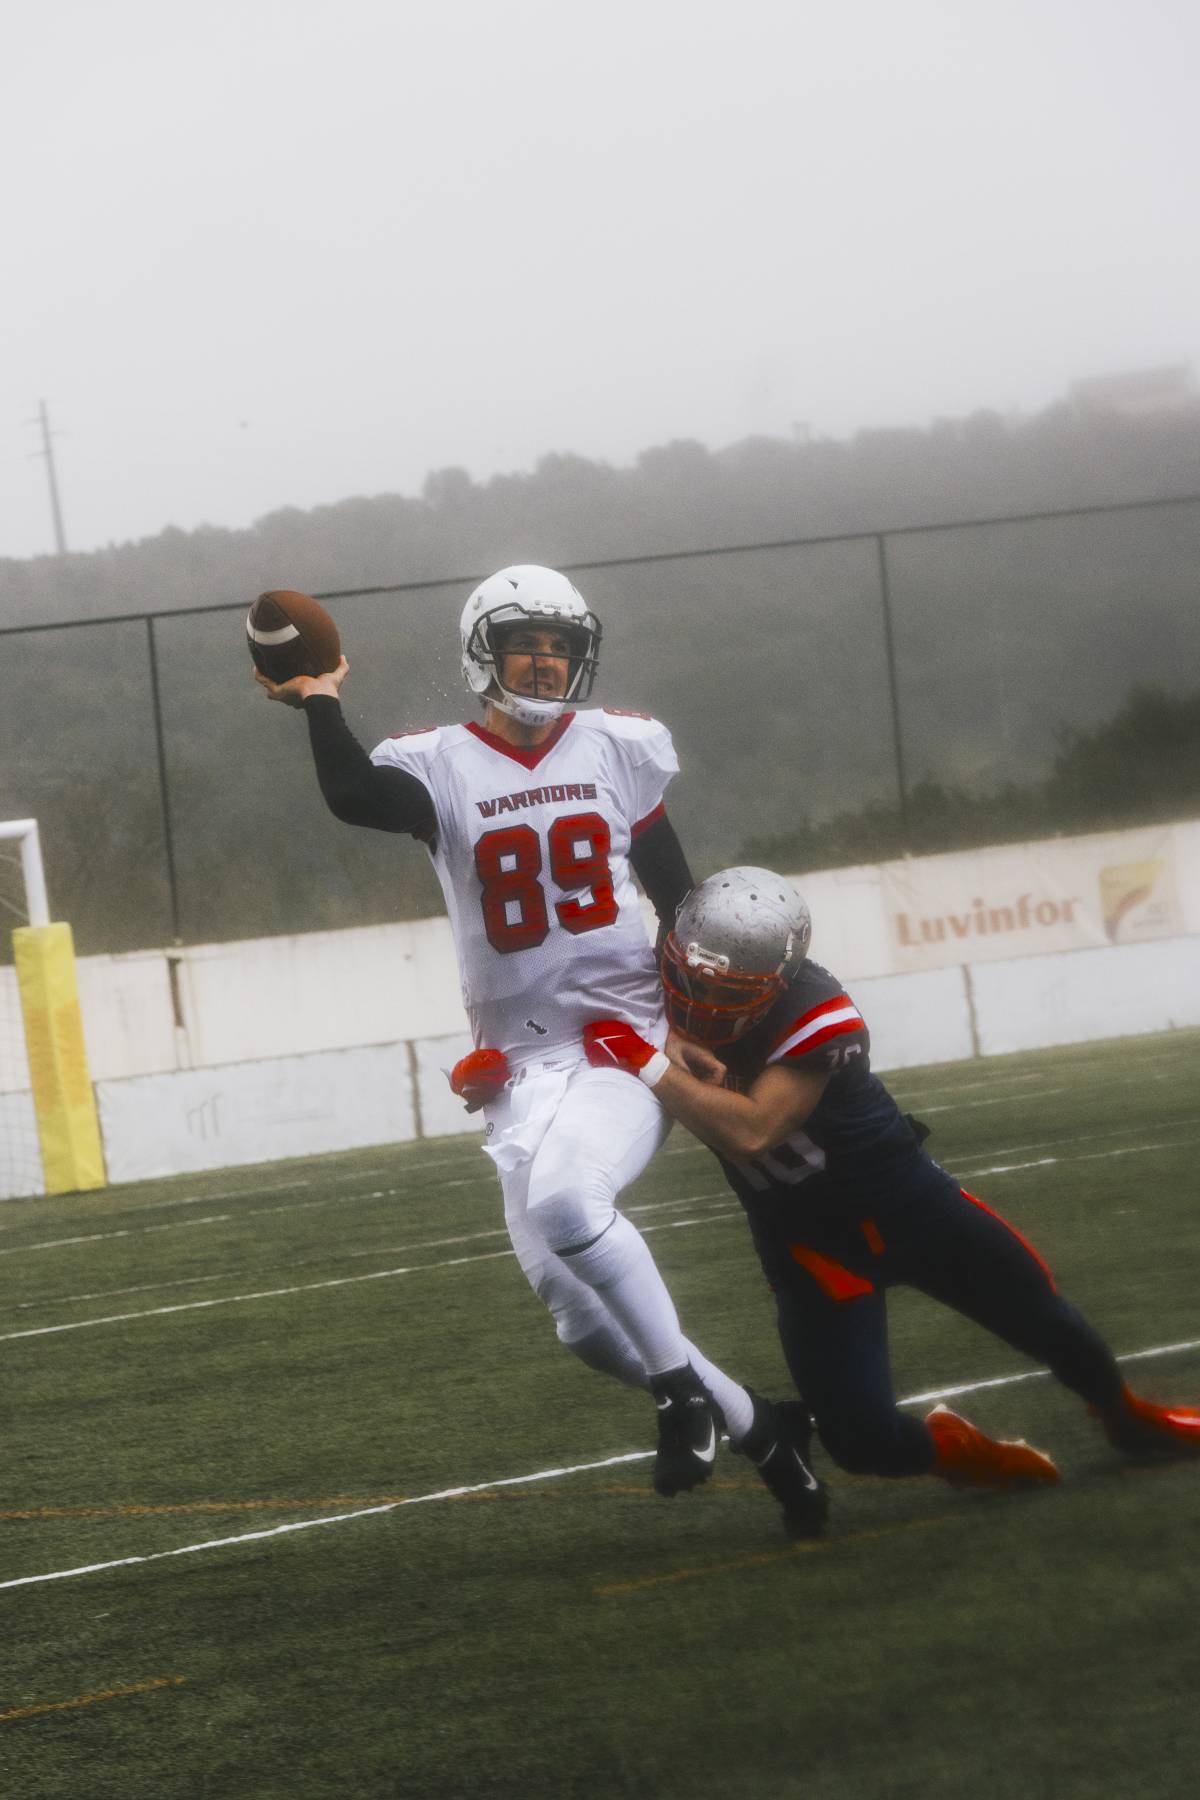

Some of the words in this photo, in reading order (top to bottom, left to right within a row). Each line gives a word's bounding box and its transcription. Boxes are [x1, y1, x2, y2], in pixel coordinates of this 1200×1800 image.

[475, 783, 598, 818] WARRIORS
[474, 811, 619, 954] 89
[895, 893, 1079, 946] Luvinfor
